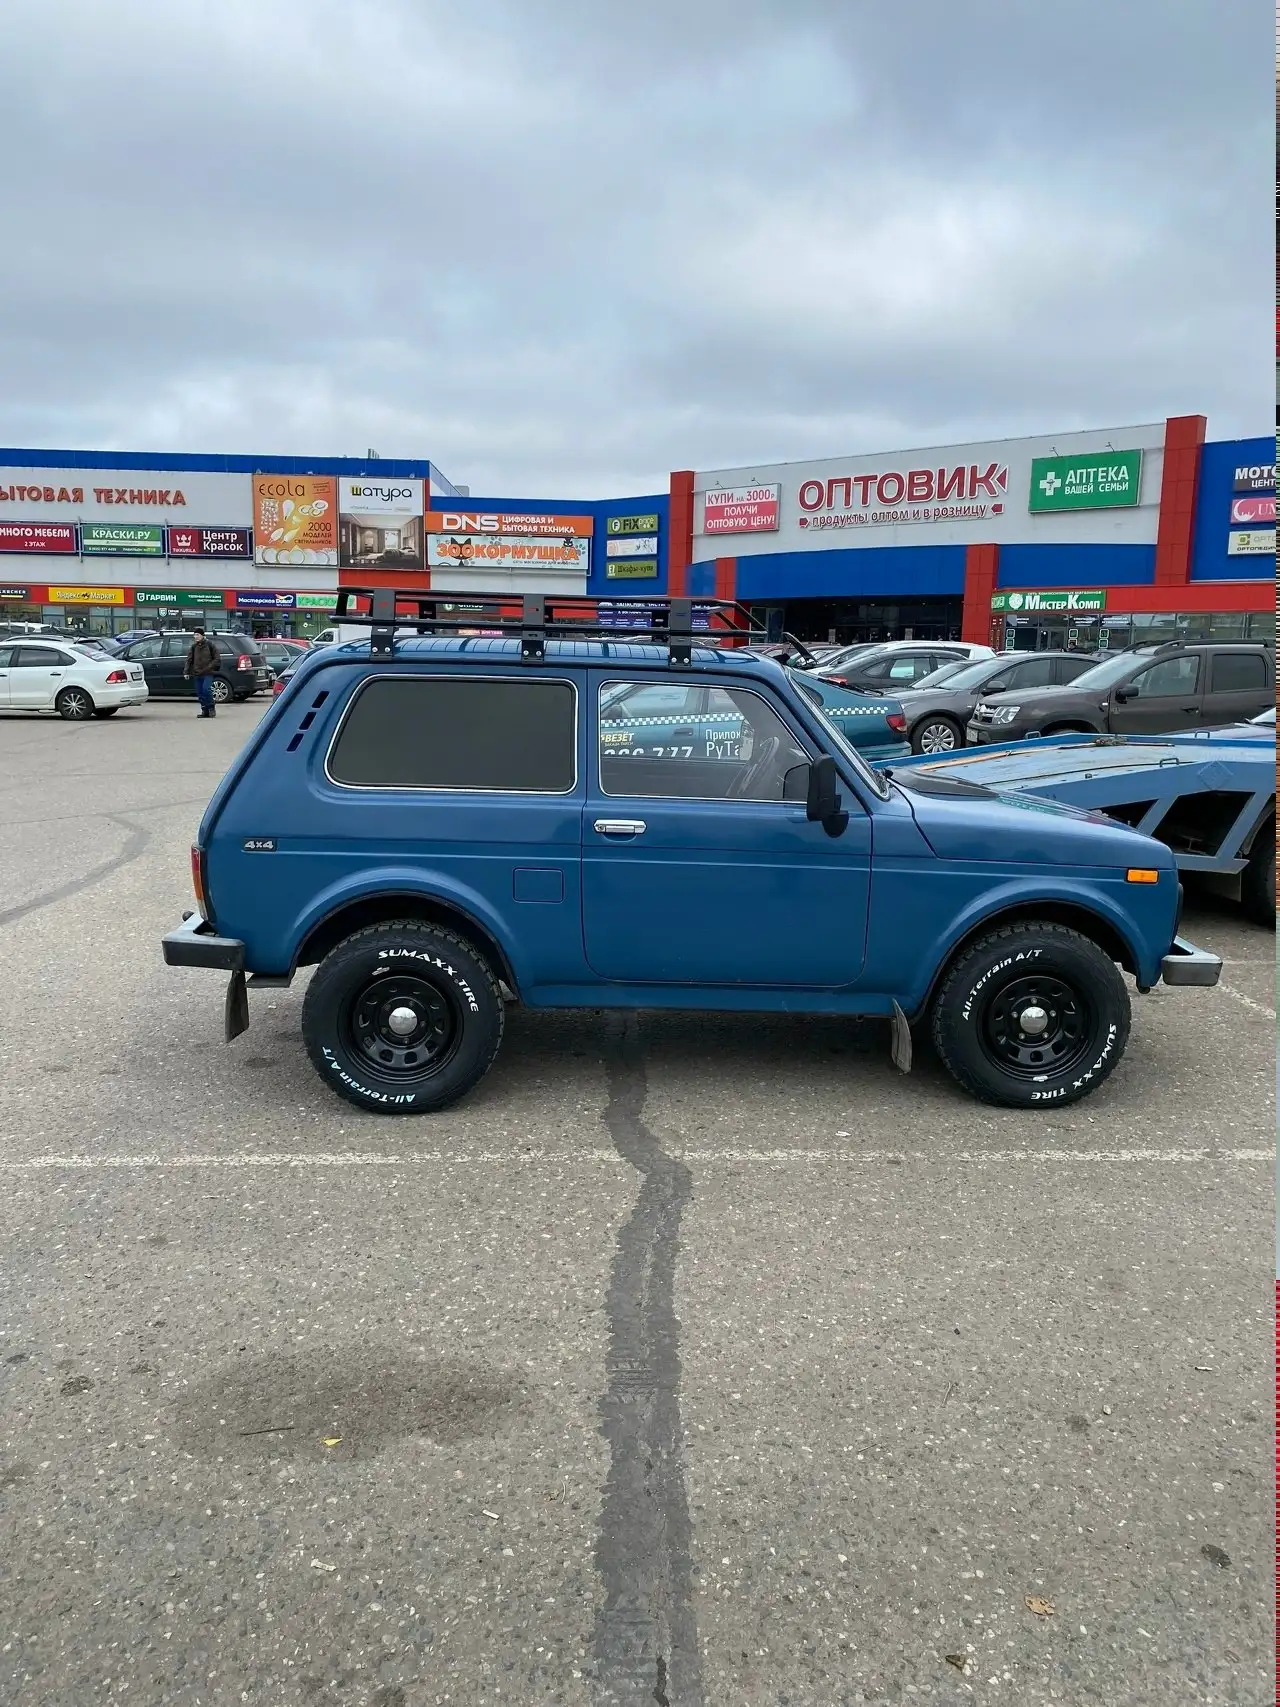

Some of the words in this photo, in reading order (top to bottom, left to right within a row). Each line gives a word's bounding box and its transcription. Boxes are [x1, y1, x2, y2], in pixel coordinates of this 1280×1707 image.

[1065, 465, 1129, 485] АПТЕКА
[798, 463, 1000, 512] ОПТОВИК
[1064, 482, 1094, 495] ВАШЕЙ
[1099, 482, 1129, 492] СЕМЬИ
[1251, 479, 1276, 489] ЦЕНТ
[93, 488, 187, 506] ТЕХНИКА
[708, 493, 734, 505] КУПИ
[724, 505, 758, 516] ПОЛУЧИ
[812, 511, 868, 529] продукты
[871, 510, 910, 522] оптом
[912, 509, 920, 519] и
[923, 508, 930, 518] в
[933, 504, 987, 519] розницу
[442, 514, 500, 532] DNS
[502, 515, 545, 524] ЦИФРОВАЯ
[707, 517, 748, 529] ОПТОВУЮ
[750, 514, 775, 526] ЦЕНУ!
[34, 528, 70, 538] МЕБЕЛИ
[308, 522, 332, 532] 2000
[502, 525, 537, 533] БЫТОВАЯ
[540, 526, 575, 534] ТЕХНИКА
[92, 529, 151, 540] КРАСКИ.РУ
[203, 530, 237, 542] Центр
[203, 541, 243, 553] Красок
[436, 542, 580, 561] ЗООКОРМУШКА
[56, 591, 81, 600] Яндекс
[90, 592, 116, 601] Маркет
[146, 594, 177, 602] ГАРВИН
[605, 731, 635, 743] ВЕЗЁТ
[962, 956, 1012, 1021] All-Terrain
[1015, 949, 1043, 962] A/T
[458, 978, 480, 1012] TIRE
[322, 1046, 341, 1070] A/T
[1030, 1087, 1067, 1100] TIRE
